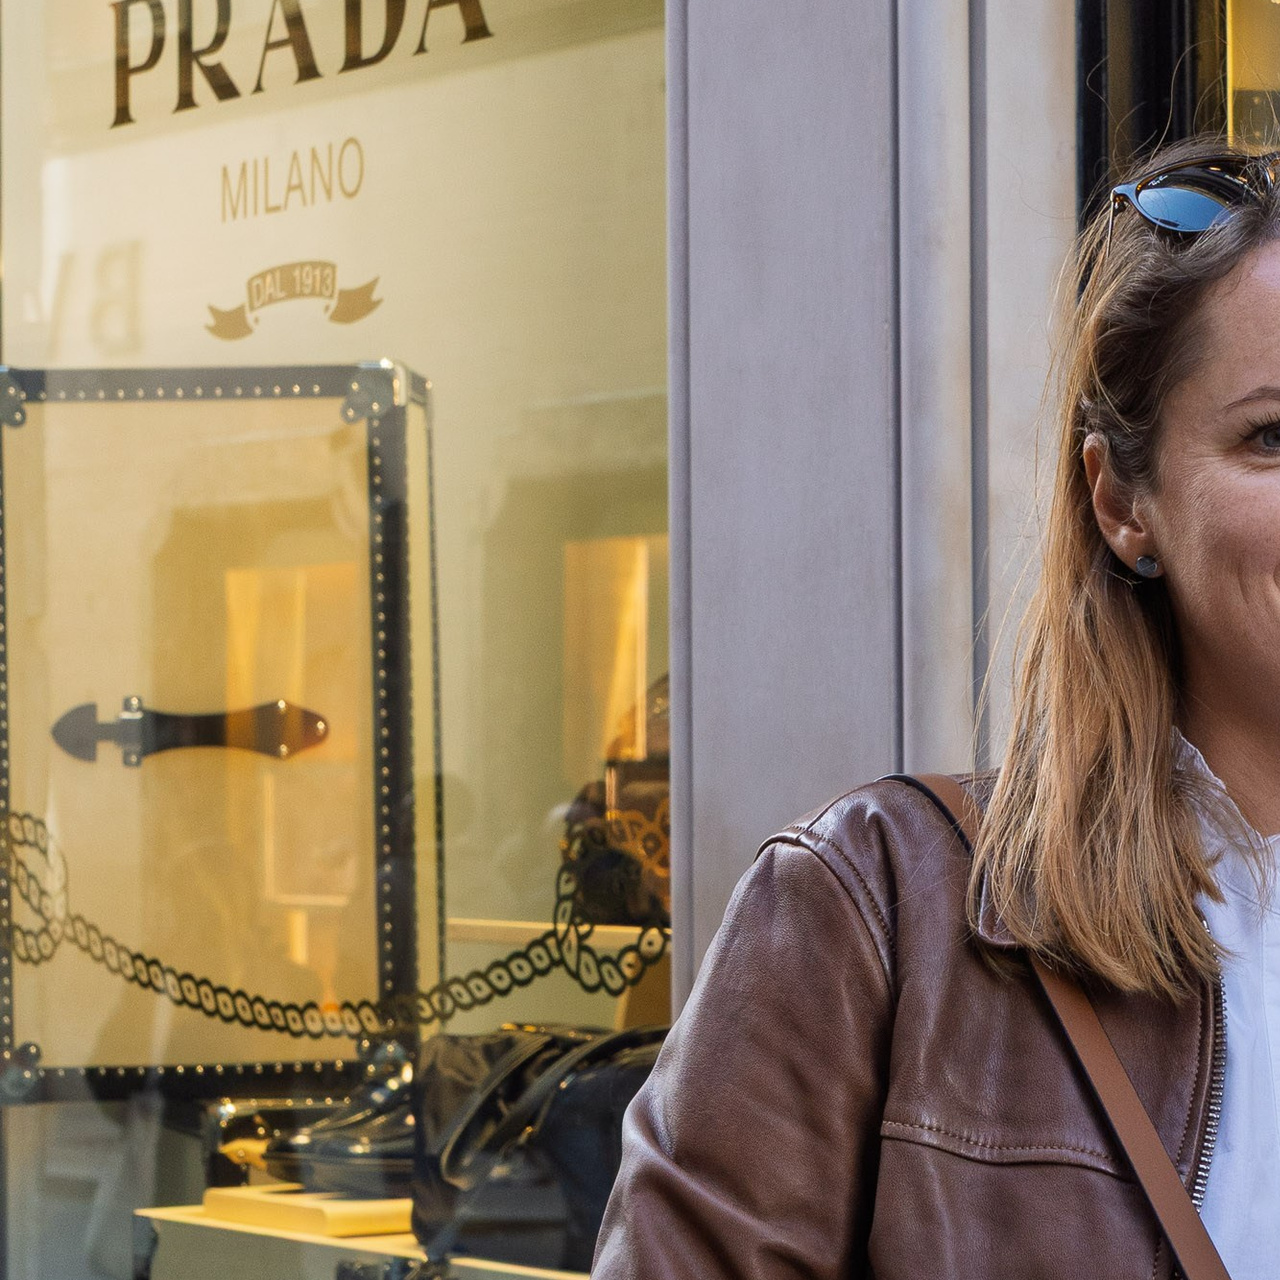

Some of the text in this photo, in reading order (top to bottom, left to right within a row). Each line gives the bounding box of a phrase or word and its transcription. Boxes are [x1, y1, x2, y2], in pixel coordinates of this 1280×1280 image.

[220, 137, 365, 224] MILANO
[251, 264, 333, 309] DAL 1913
